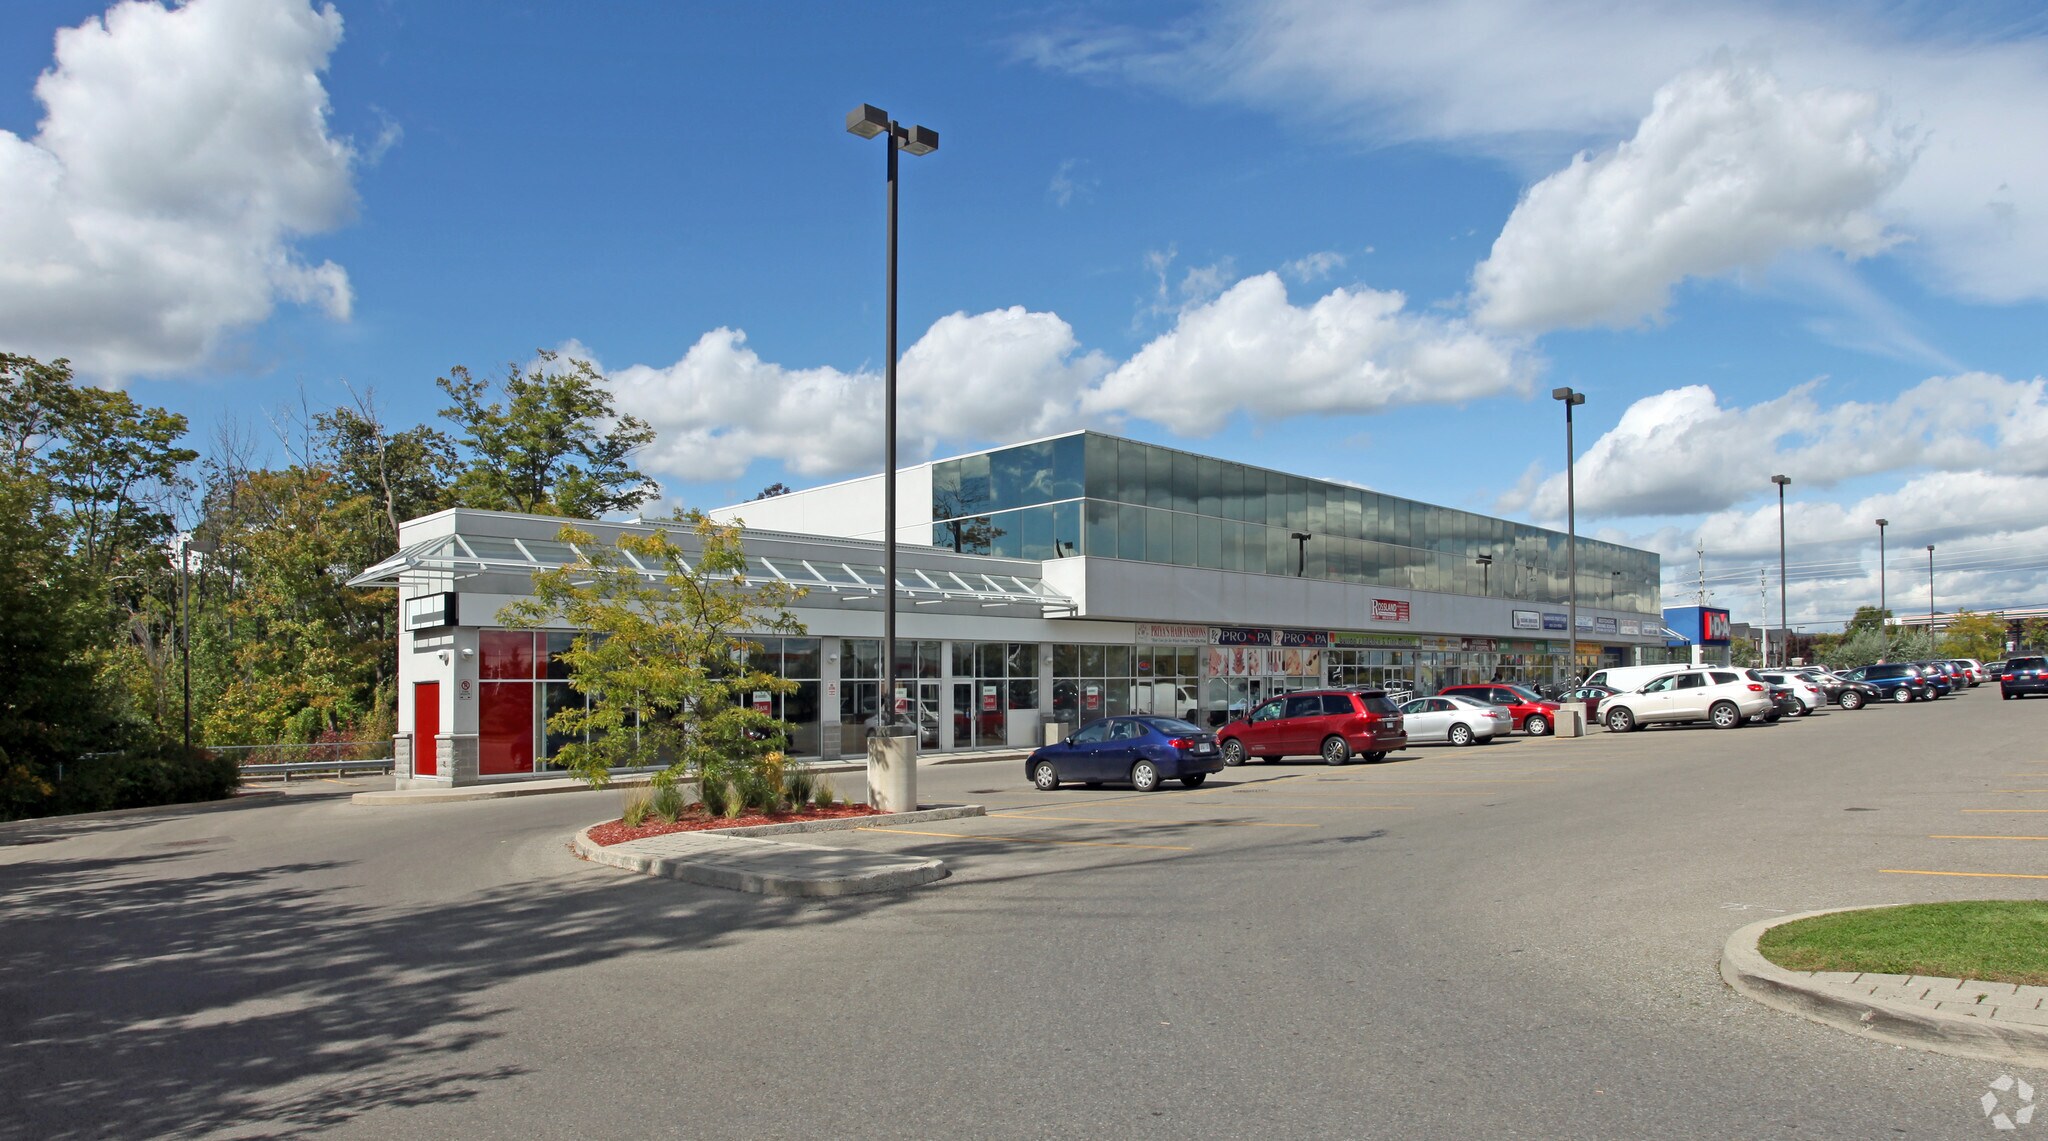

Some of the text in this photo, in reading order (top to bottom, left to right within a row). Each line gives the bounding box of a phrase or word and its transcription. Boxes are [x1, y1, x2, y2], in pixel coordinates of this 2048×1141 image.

[1372, 600, 1397, 616] ROSSLAND
[1171, 626, 1183, 637] HAIR
[1184, 626, 1206, 638] FASHIONS
[1222, 631, 1247, 642] PRO
[1284, 632, 1306, 644] PRO
